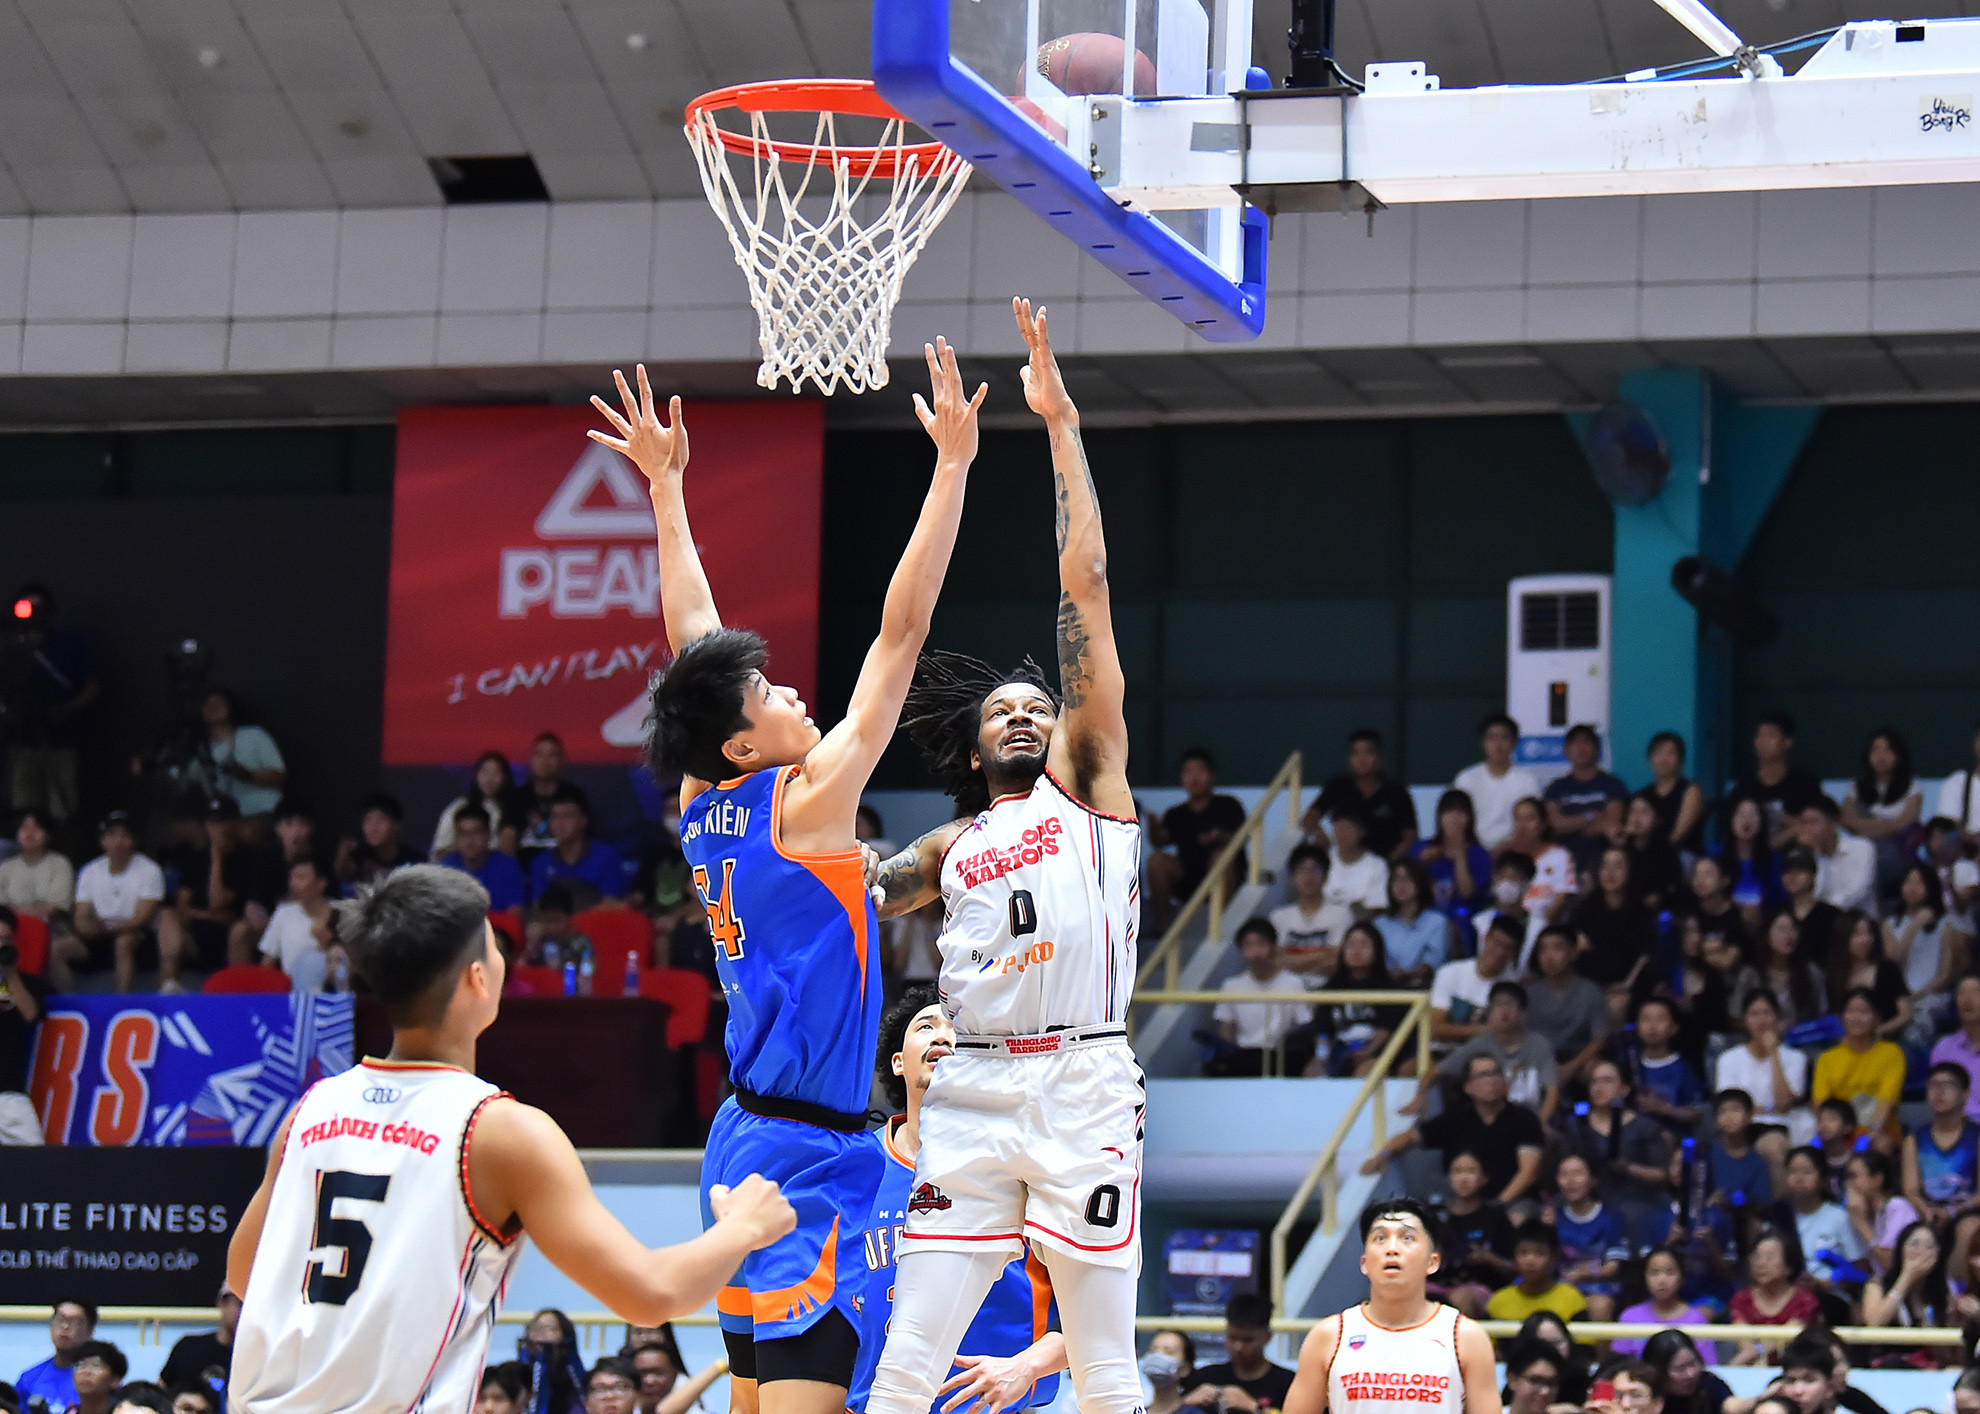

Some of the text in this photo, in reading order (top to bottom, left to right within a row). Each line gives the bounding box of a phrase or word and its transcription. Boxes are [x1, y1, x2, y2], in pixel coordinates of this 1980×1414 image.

[956, 817, 1063, 877] THAONG
[1009, 890, 1037, 939] 0
[972, 951, 983, 963] By
[1005, 1035, 1062, 1047] THANGLONG
[1009, 1043, 1059, 1054] WARRIORS
[1085, 1184, 1120, 1228] 0
[0, 1202, 228, 1233] LITE FITNESS
[301, 1168, 392, 1306] 5
[74, 1250, 120, 1270] THAO
[123, 1251, 160, 1271] CAO
[1340, 1372, 1450, 1389] THANGLONG
[1346, 1386, 1443, 1404] WARRIORS
